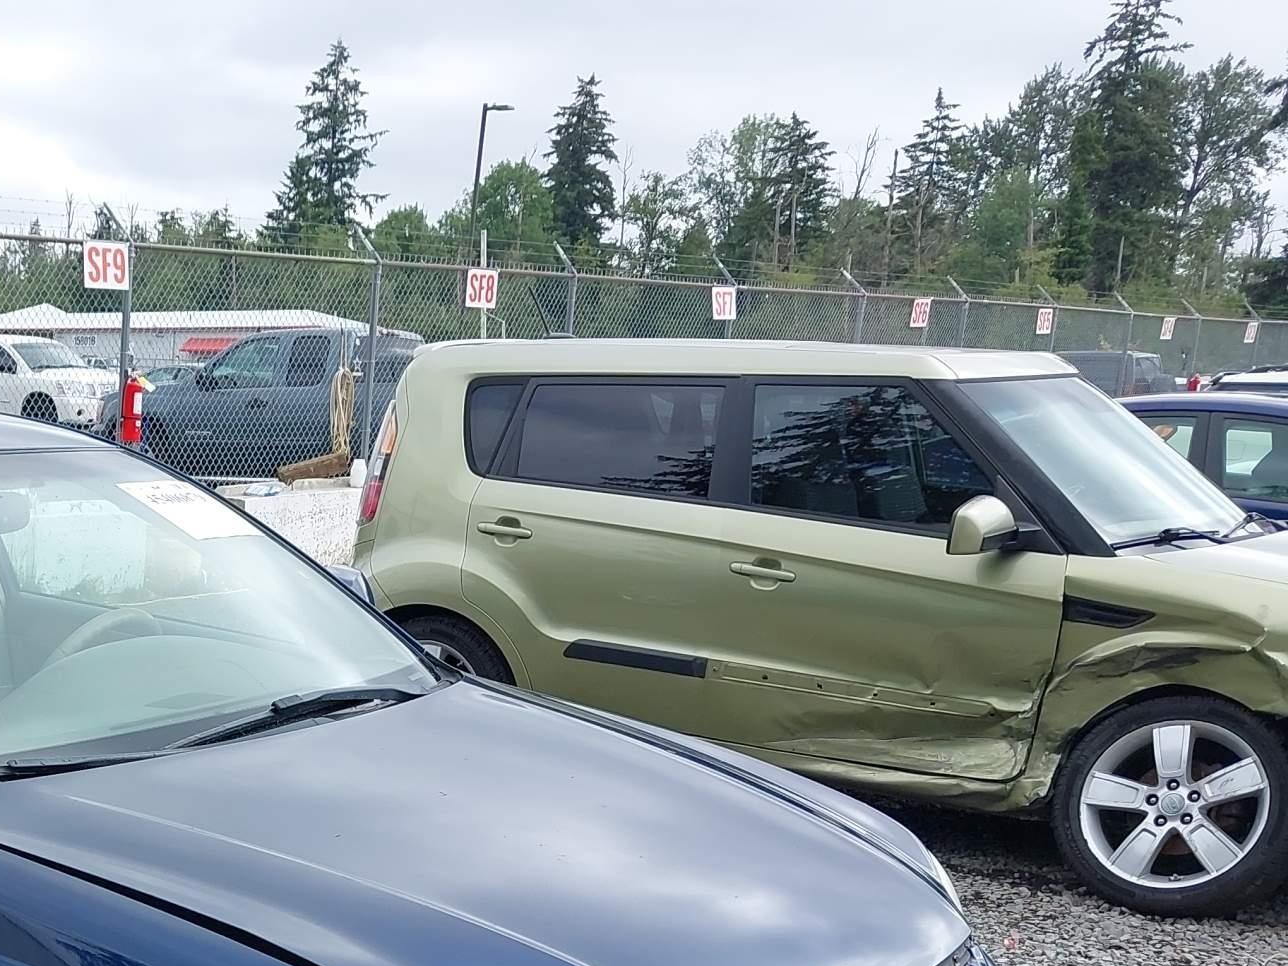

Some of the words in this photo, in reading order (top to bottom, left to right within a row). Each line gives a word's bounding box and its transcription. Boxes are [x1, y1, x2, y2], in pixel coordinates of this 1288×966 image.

[87, 246, 126, 284] SF9
[469, 273, 495, 304] SF8
[715, 291, 733, 317] SF7
[912, 302, 929, 324] SF6
[1038, 311, 1052, 331] SF5
